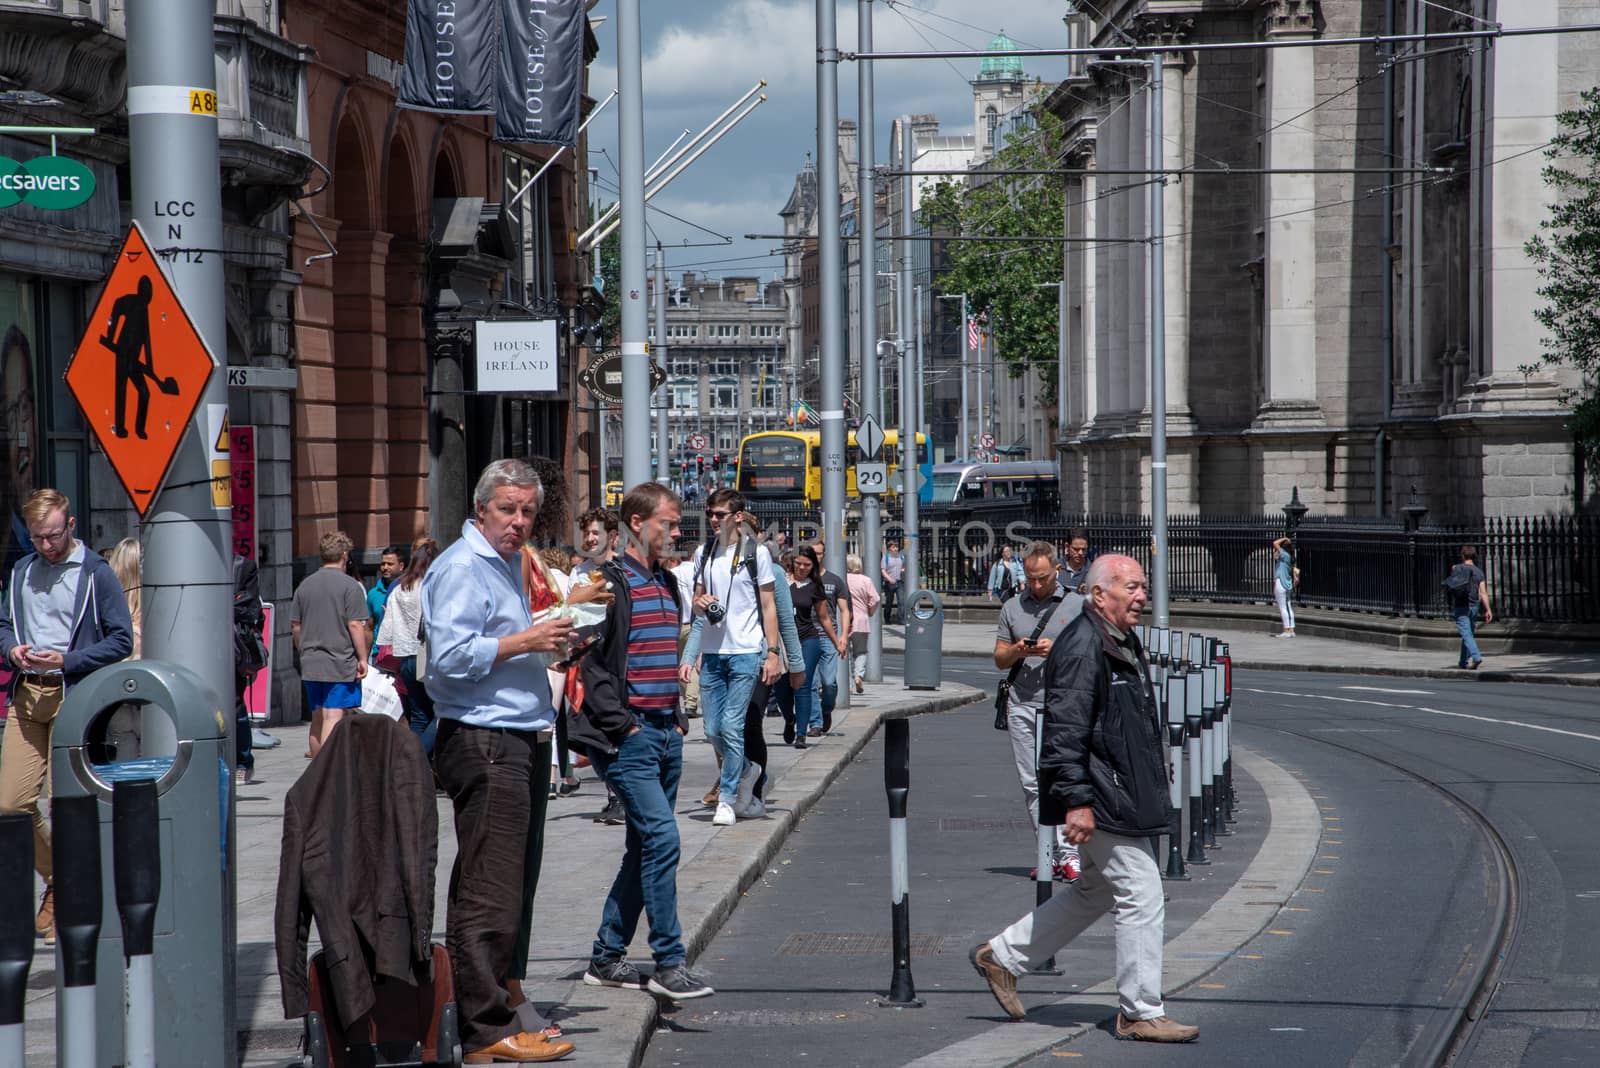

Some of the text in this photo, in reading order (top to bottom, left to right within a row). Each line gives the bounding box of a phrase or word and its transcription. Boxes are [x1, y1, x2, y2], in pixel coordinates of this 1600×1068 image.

[436, 2, 455, 104] HOUSE
[525, 0, 549, 134] HOUSE of I
[0, 174, 81, 191] csavers
[154, 201, 196, 217] LCC
[168, 224, 182, 240] N
[494, 341, 541, 351] HOUSE
[486, 360, 549, 370] IRELAND
[228, 369, 248, 385] KS
[860, 471, 883, 485] 20
